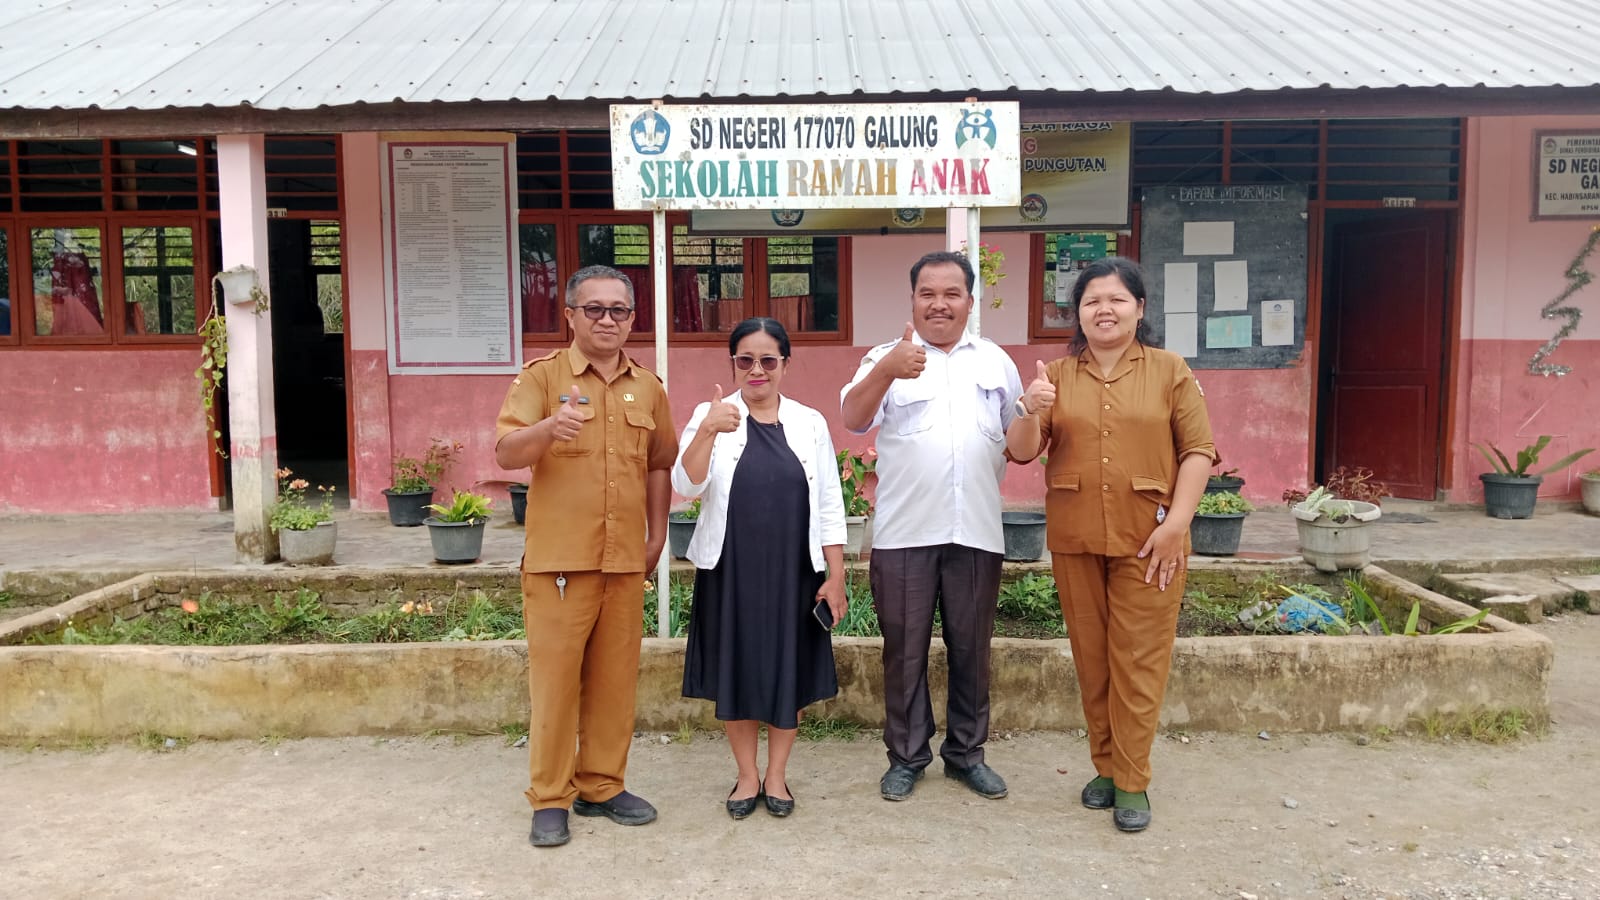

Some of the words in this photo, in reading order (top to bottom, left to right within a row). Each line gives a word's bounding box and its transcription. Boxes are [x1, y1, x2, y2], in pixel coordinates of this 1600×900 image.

[690, 117, 713, 150] SD
[719, 116, 786, 149] NEGERI
[793, 116, 855, 149] 177070
[864, 115, 938, 149] GALUNG
[1024, 157, 1107, 172] PUNGUTAN
[1548, 159, 1566, 174] SD
[640, 158, 778, 199] SEKOLAH
[786, 158, 898, 197] RAMAH
[909, 157, 991, 196] ANAK
